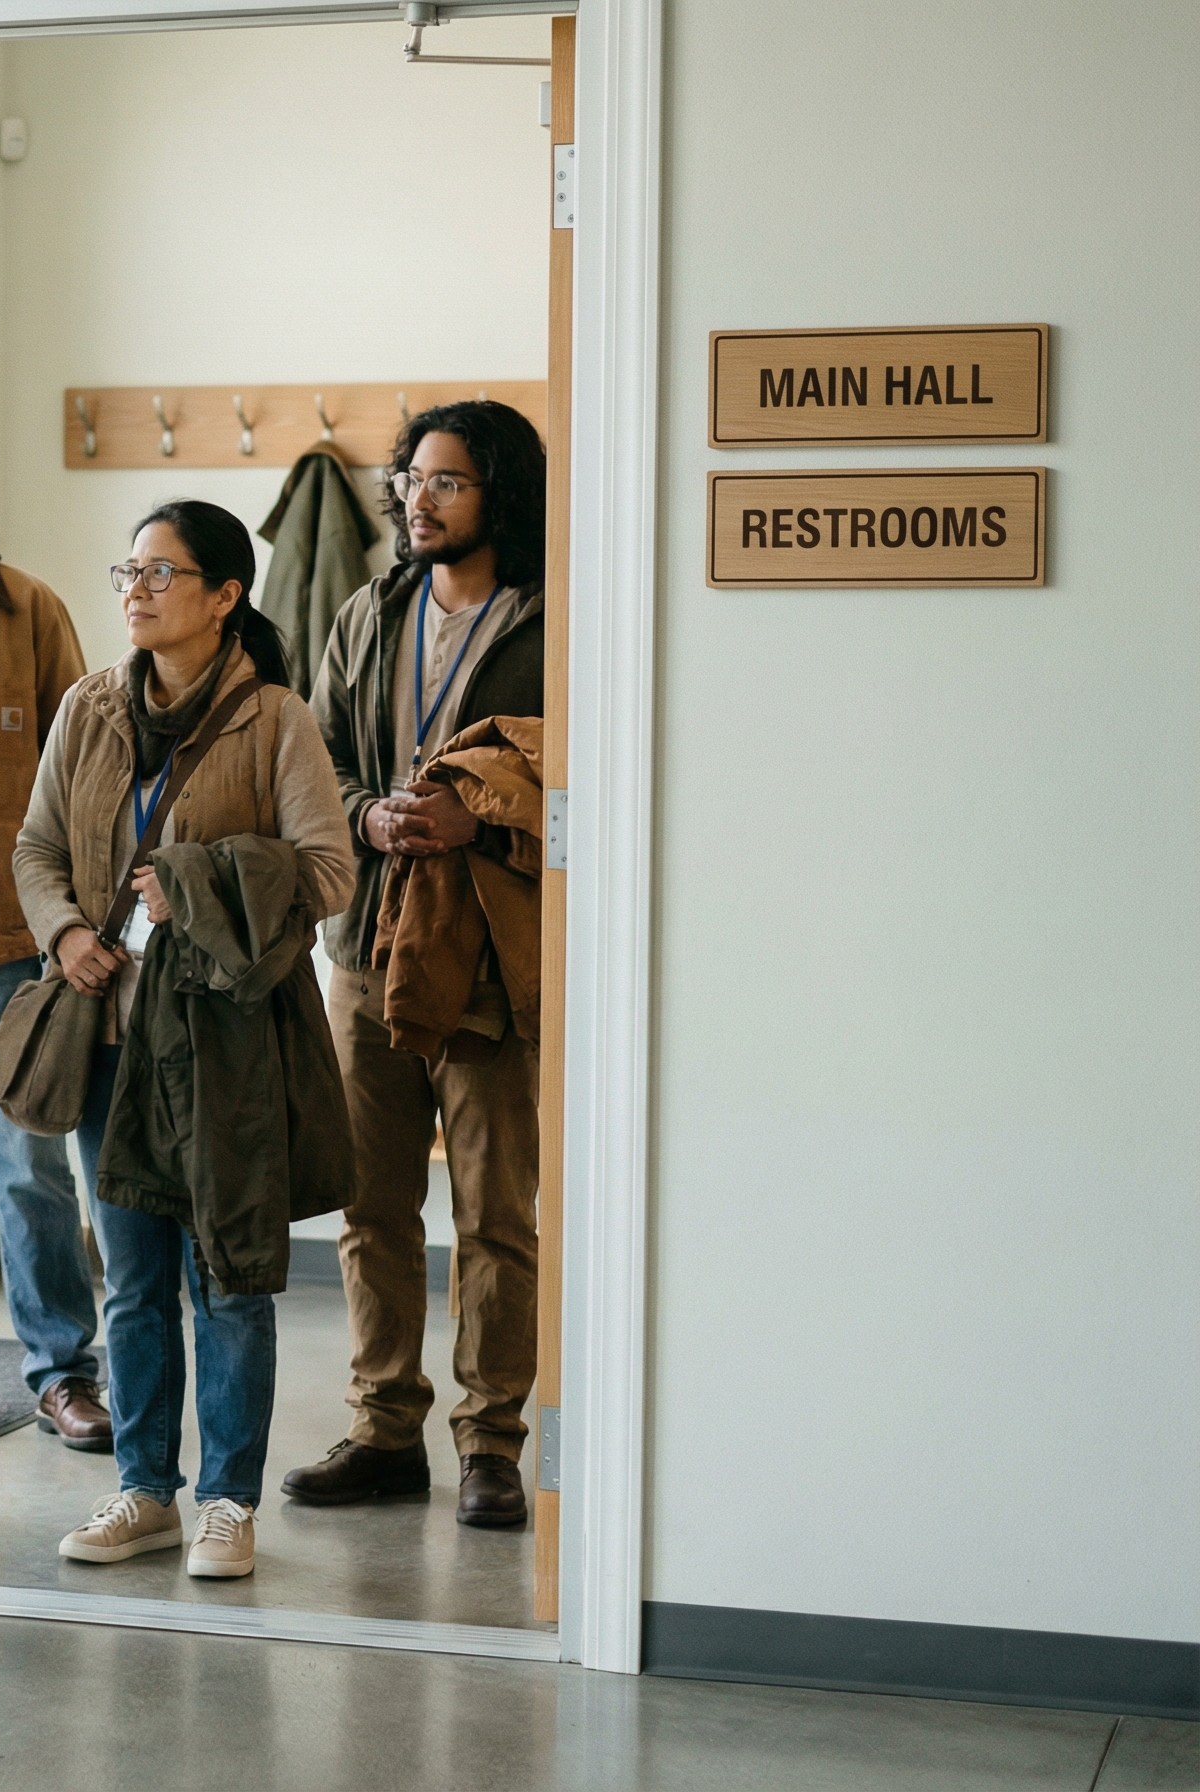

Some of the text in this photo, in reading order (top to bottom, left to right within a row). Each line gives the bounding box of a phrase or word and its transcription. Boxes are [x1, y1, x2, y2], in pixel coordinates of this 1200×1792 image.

[759, 363, 994, 408] MAIN HALL
[741, 505, 1007, 549] RESTROOMS
